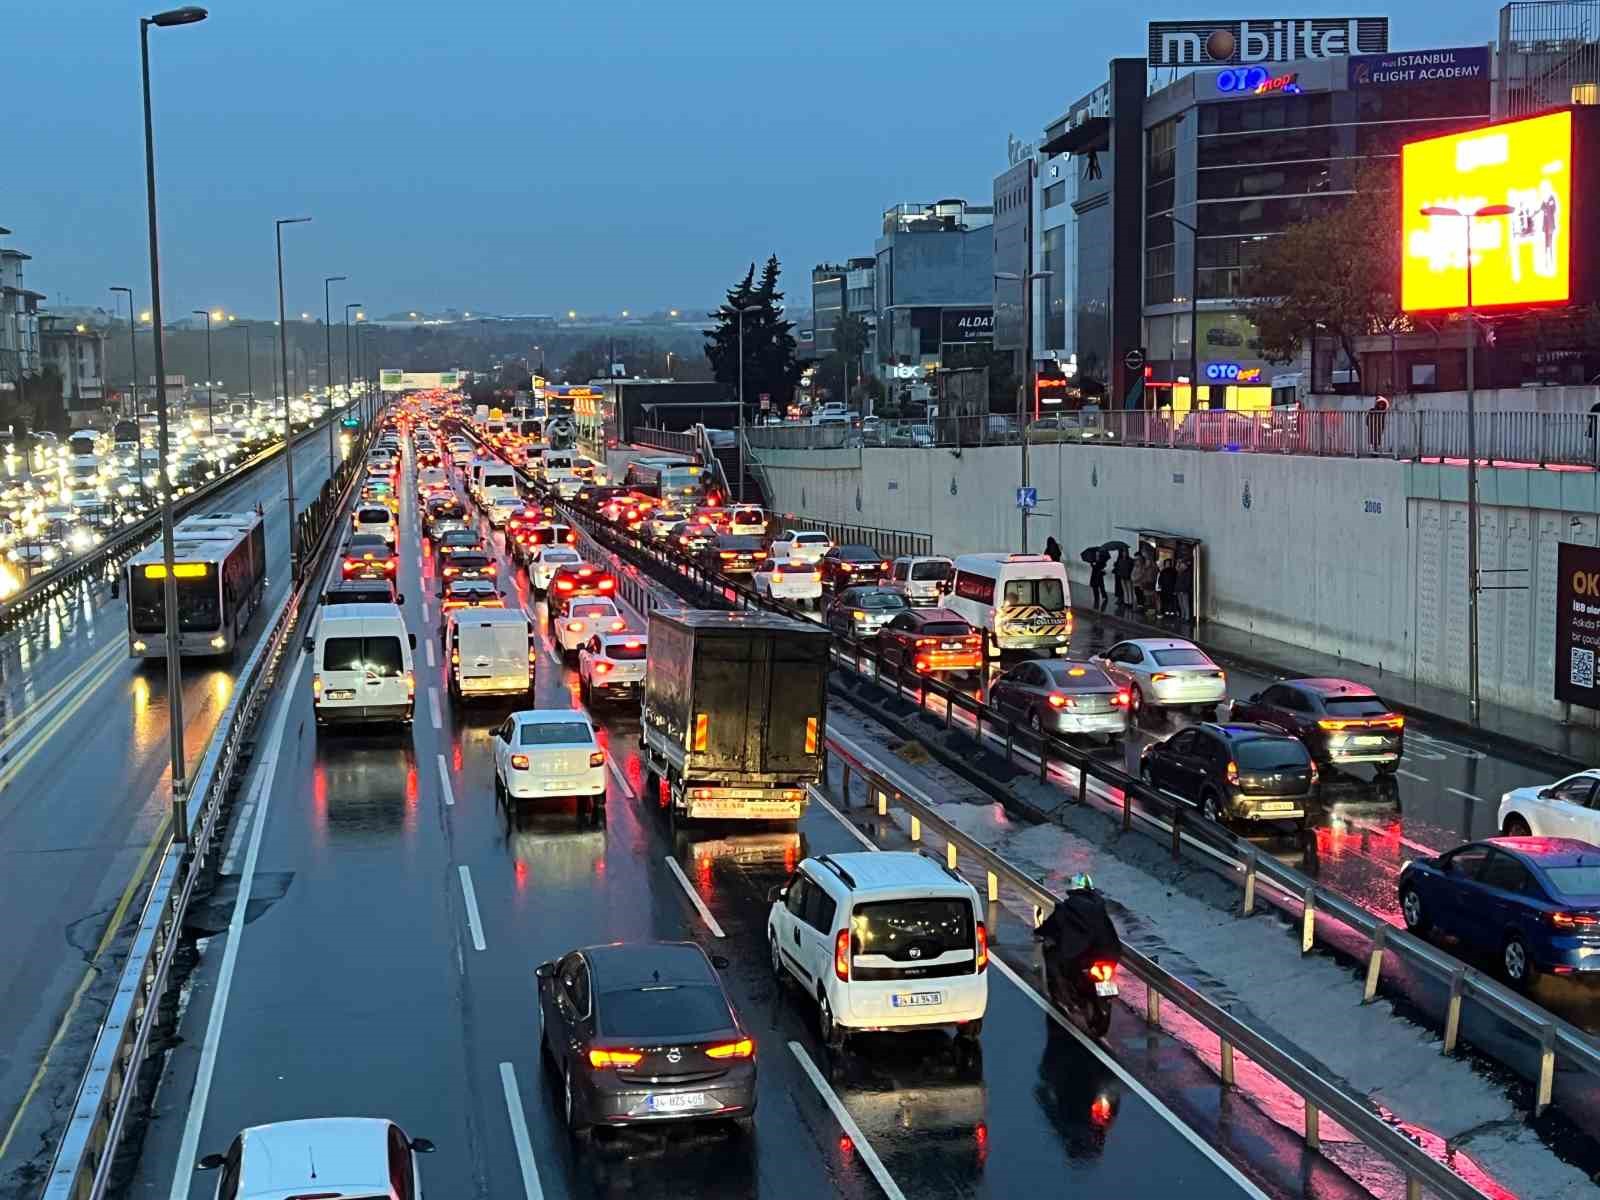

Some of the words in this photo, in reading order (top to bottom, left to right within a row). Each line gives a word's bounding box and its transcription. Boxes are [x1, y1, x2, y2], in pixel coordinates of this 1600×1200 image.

[1161, 19, 1382, 64] mobiltel
[1216, 66, 1269, 92] OTO
[1373, 70, 1416, 83] FLIGHT
[1418, 65, 1481, 80] ACADEMY
[1206, 364, 1238, 379] OTO
